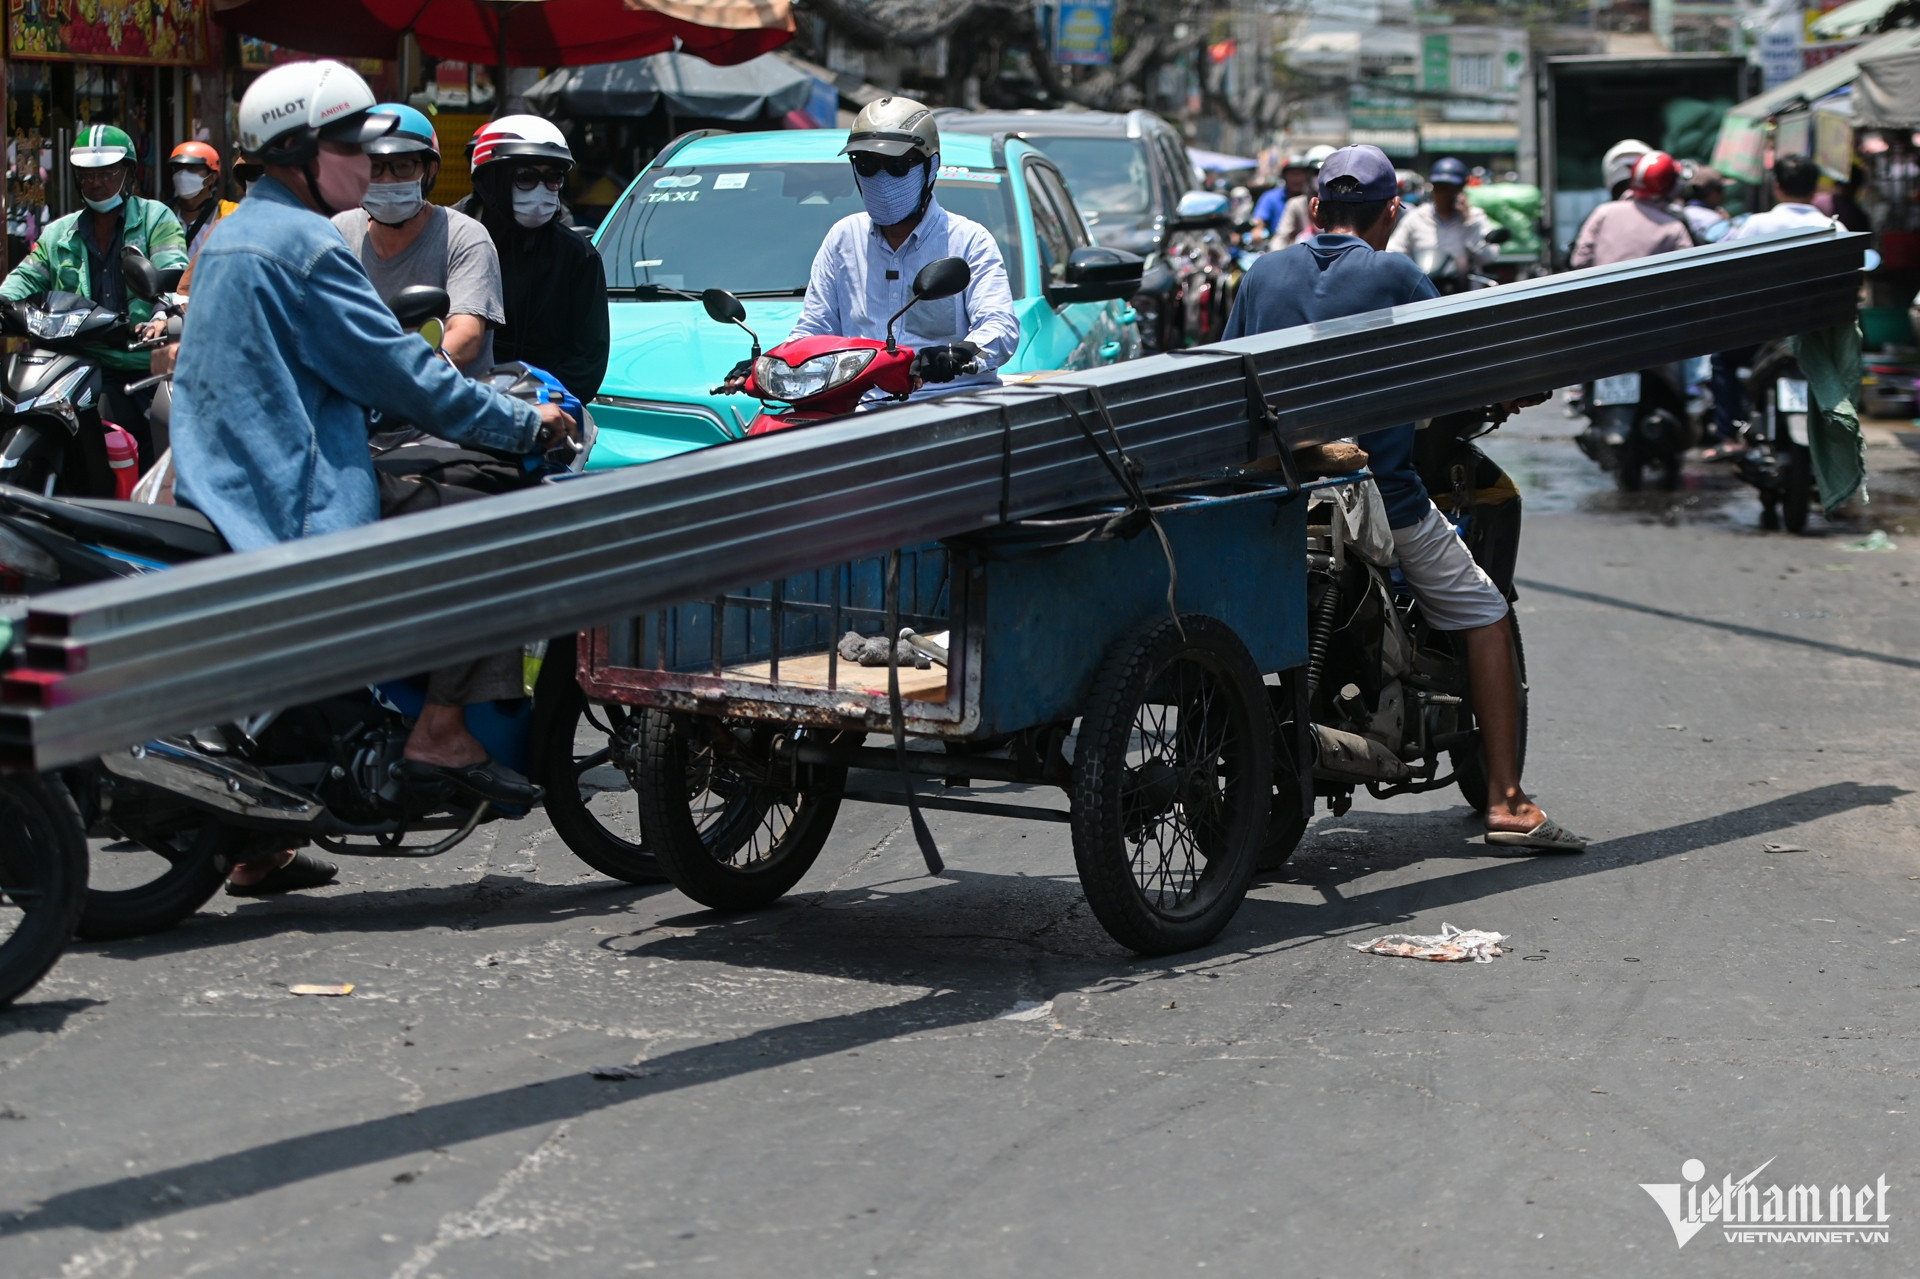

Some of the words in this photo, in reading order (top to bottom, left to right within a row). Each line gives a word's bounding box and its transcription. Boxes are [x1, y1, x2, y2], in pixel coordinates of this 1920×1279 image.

[261, 98, 306, 124] PILOT
[320, 101, 351, 119] ANDES
[648, 190, 700, 203] TAXI
